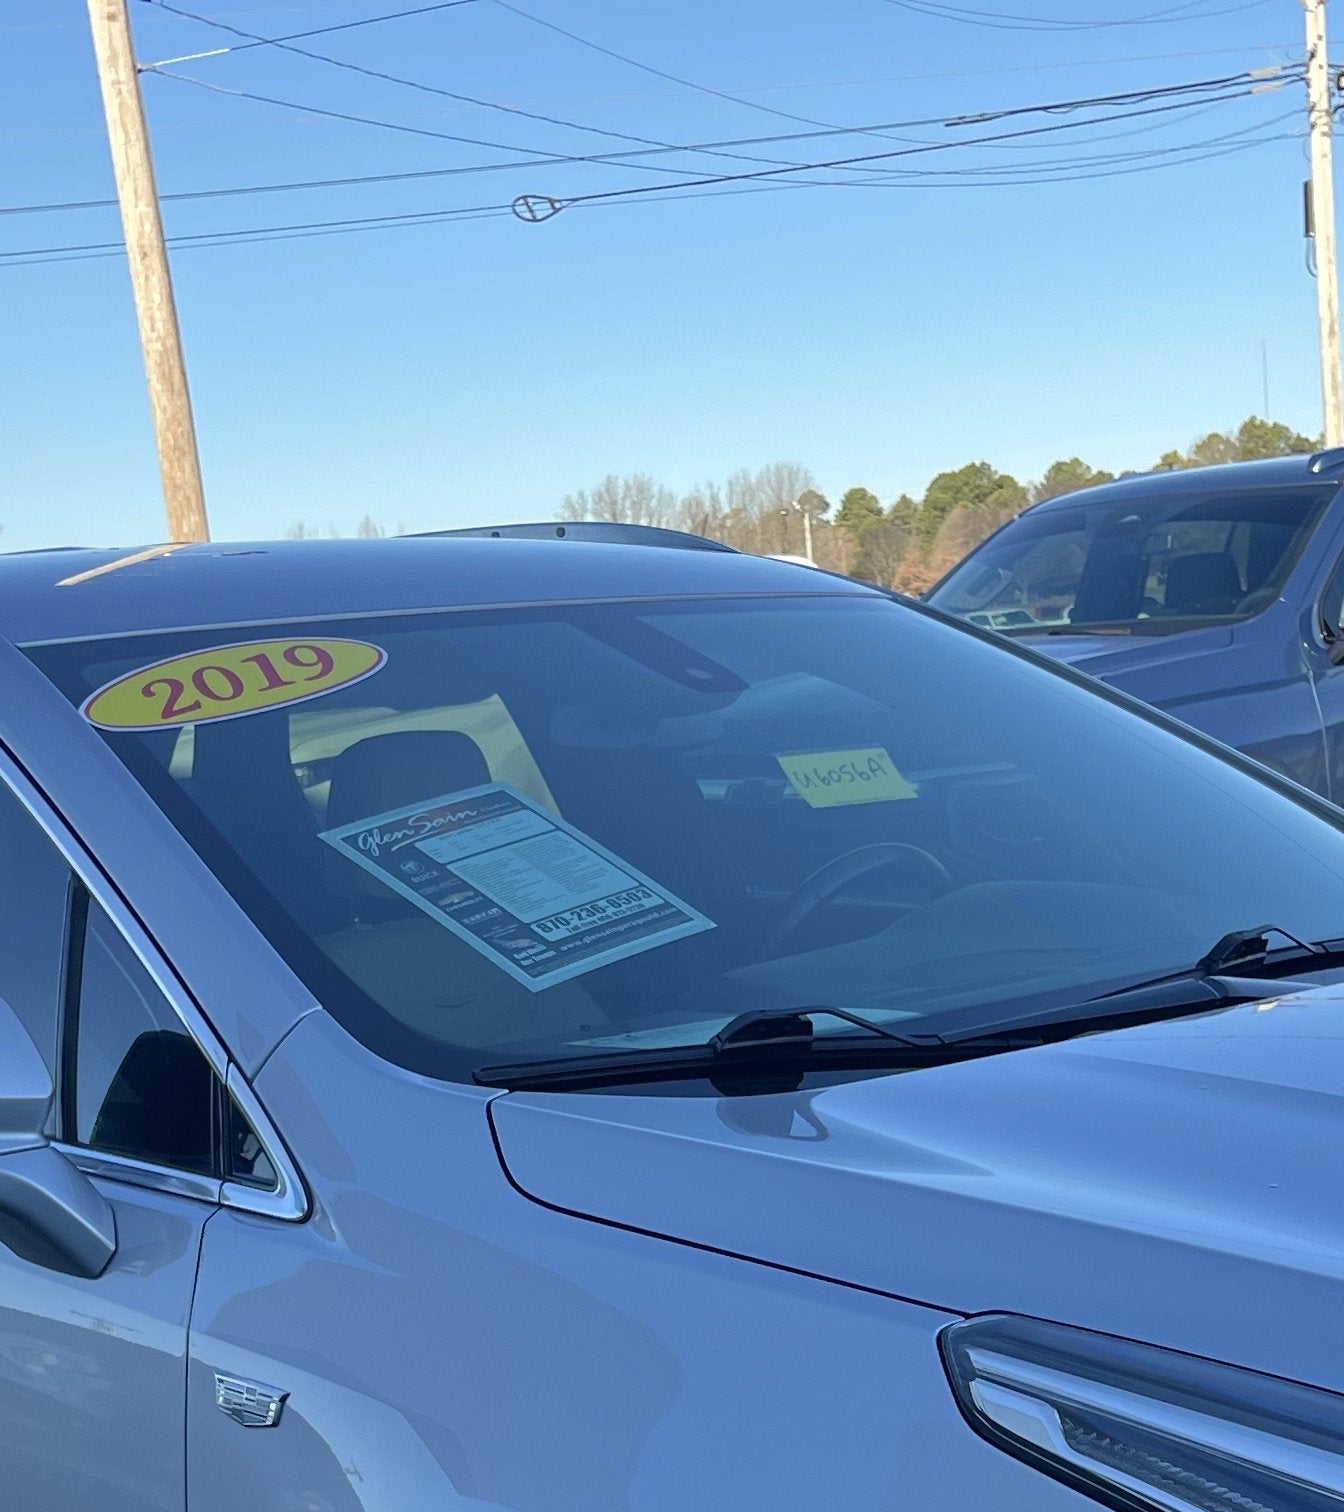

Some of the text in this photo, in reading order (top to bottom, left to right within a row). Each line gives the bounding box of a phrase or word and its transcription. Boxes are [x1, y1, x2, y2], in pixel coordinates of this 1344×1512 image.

[141, 644, 335, 720] 2019
[358, 828, 415, 857] Glen
[408, 809, 477, 834] Sain
[535, 887, 653, 934] 870-236-8503
